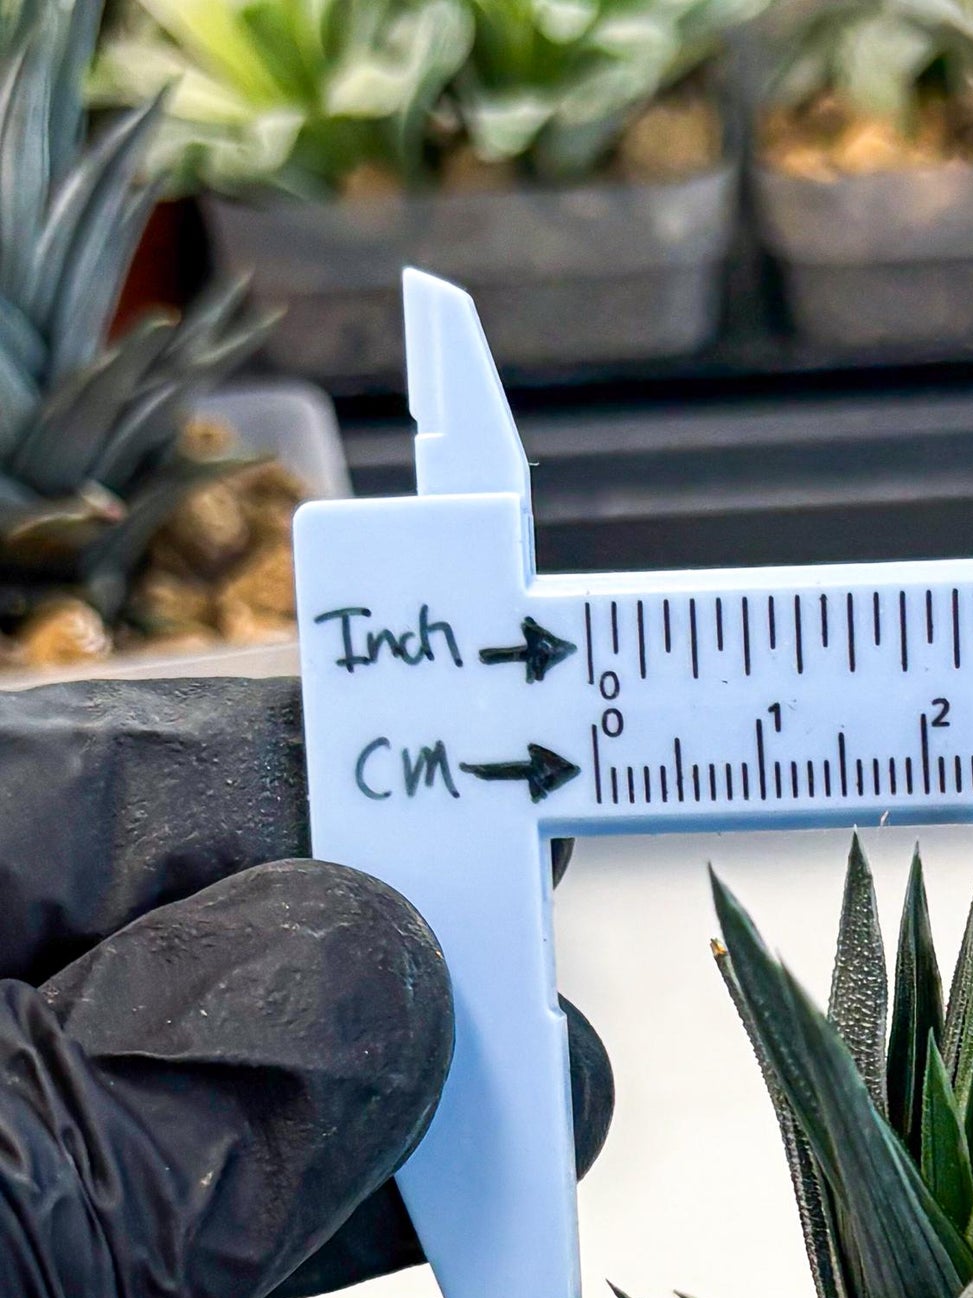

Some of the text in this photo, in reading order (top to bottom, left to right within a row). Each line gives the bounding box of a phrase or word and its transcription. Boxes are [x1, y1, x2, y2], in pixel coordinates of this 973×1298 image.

[314, 602, 463, 673] Inch
[599, 670, 621, 701] 0
[601, 707, 624, 738] 0
[767, 702, 782, 733] 1
[930, 697, 951, 728] 2
